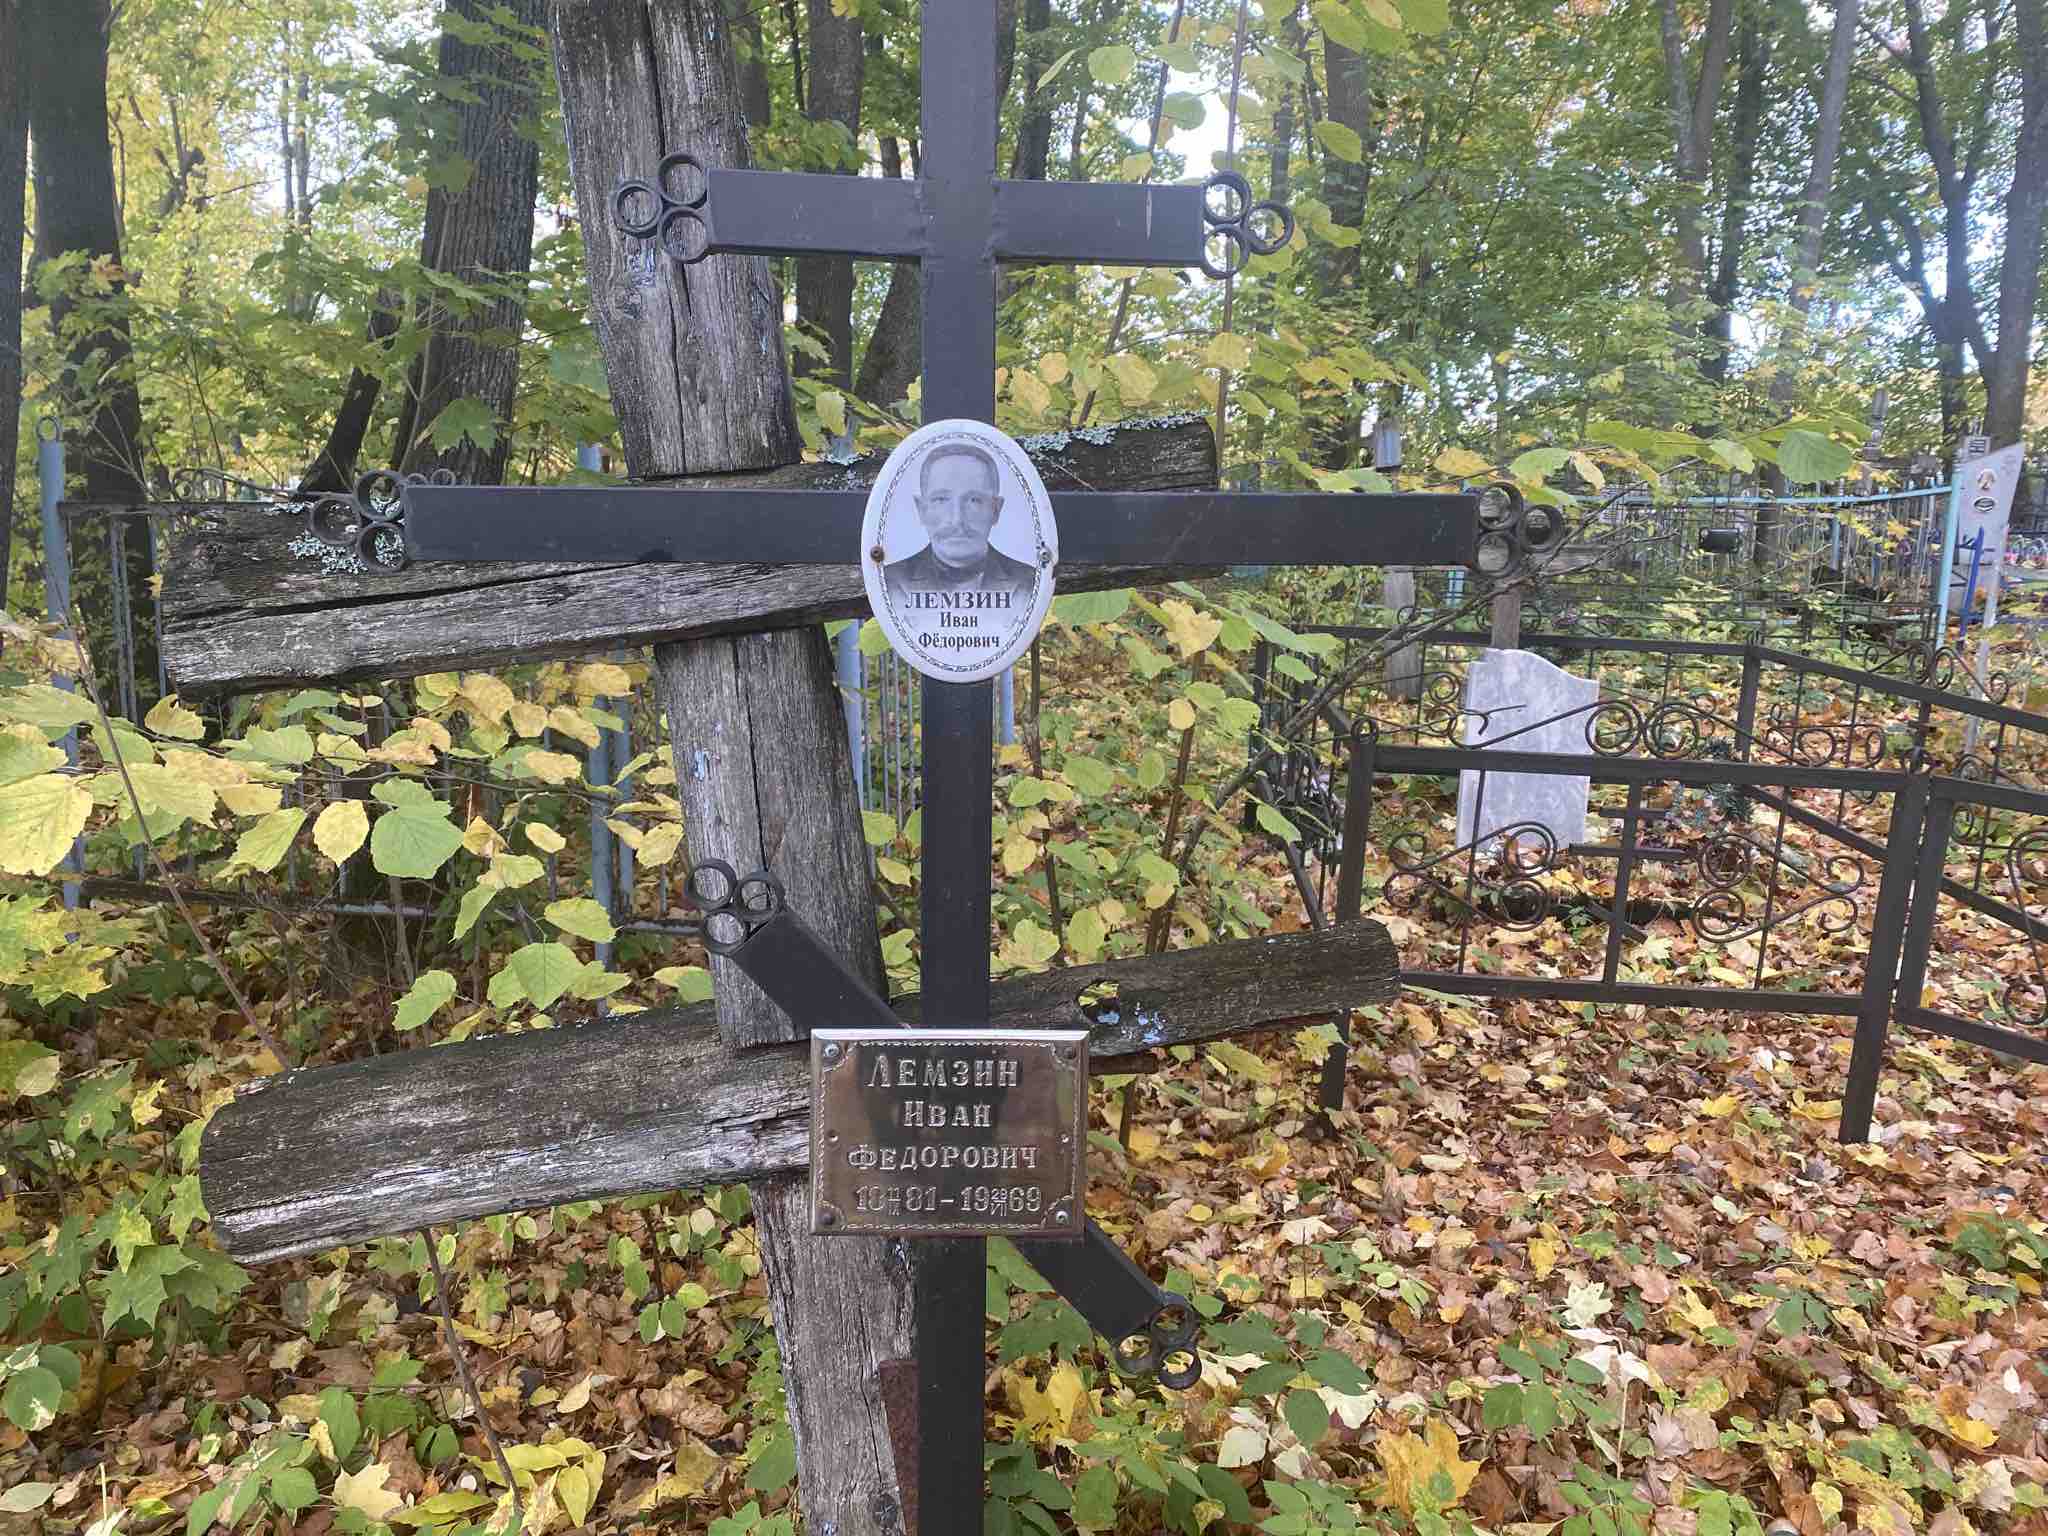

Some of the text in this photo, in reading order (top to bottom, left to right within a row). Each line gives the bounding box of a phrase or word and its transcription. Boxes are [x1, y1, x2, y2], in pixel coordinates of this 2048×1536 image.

[905, 591, 1011, 609] ЛЕМЗИН
[940, 611, 979, 627] Иван
[918, 631, 1000, 652] Фёдорович
[867, 1054, 1019, 1088] ЛЕМЗИН
[903, 1100, 992, 1128] ИВАН
[847, 1144, 1040, 1171] ФЕДОРОВИЧ
